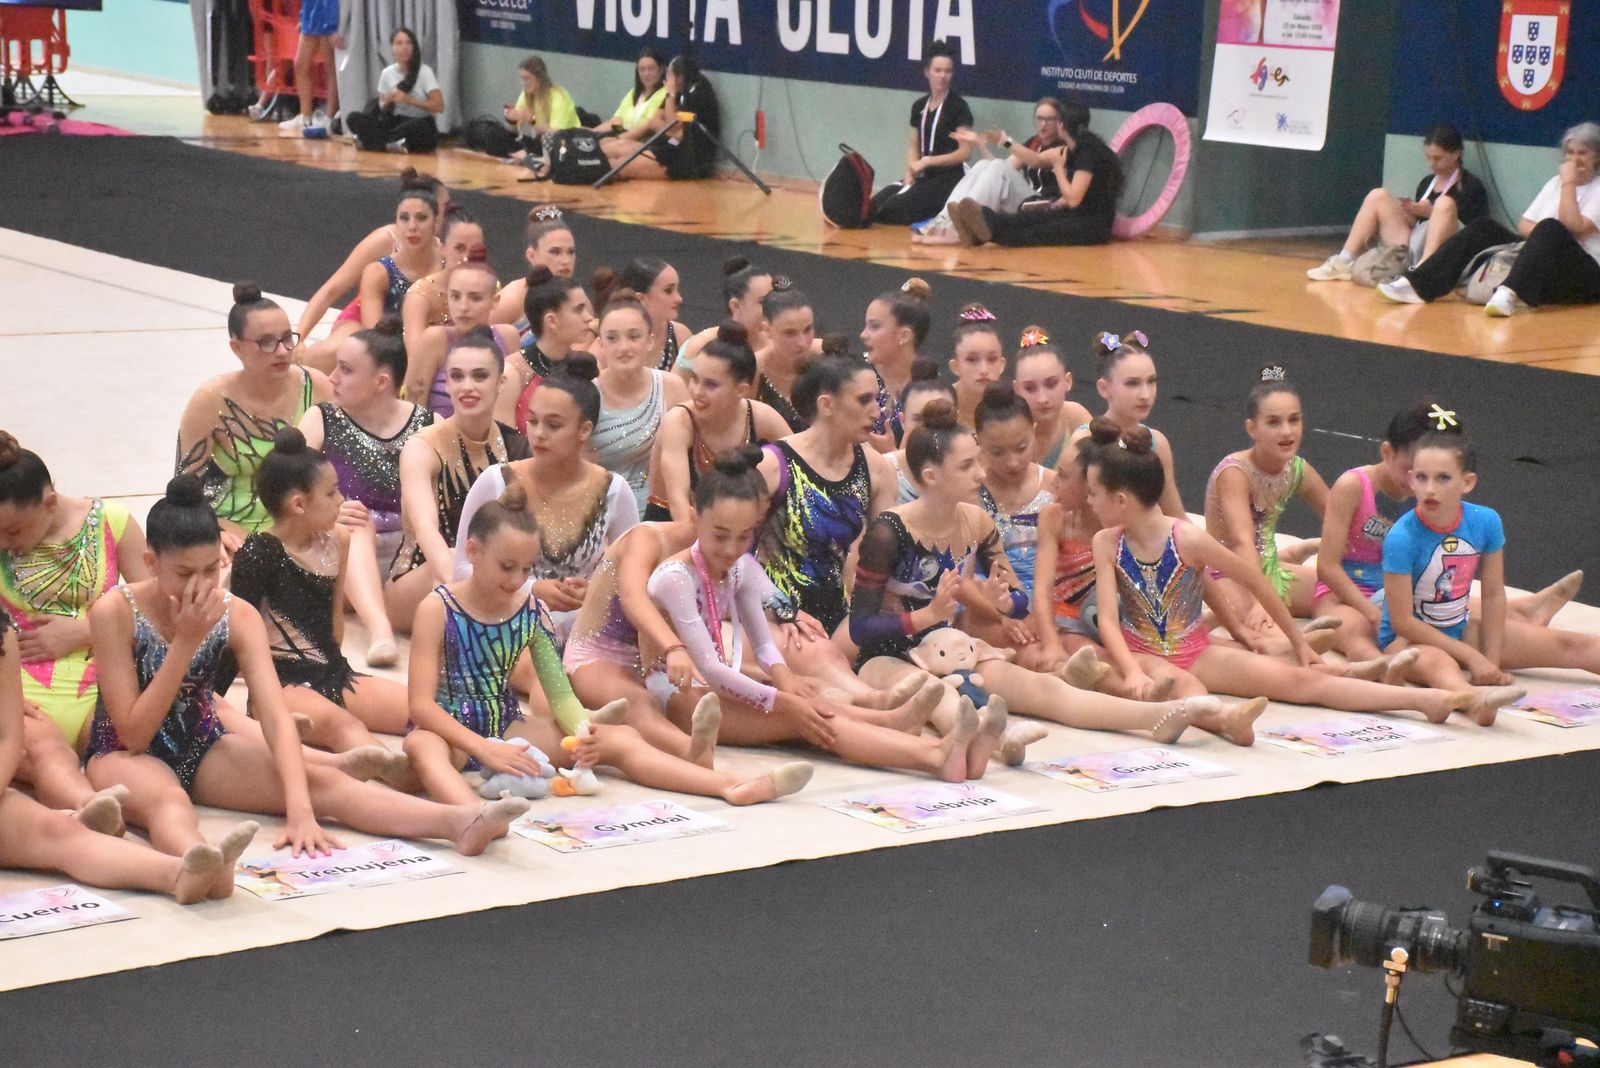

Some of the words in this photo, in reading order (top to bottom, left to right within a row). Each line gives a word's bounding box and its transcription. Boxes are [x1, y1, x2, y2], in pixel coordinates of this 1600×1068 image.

[1041, 66, 1073, 78] INSTITUTO
[1093, 70, 1103, 81] DE
[1103, 72, 1138, 84] DEPORTES
[1322, 724, 1393, 739] Puerto
[915, 796, 998, 813] Lebrija
[593, 814, 692, 834] Gymdal
[290, 854, 433, 880] Trebujena
